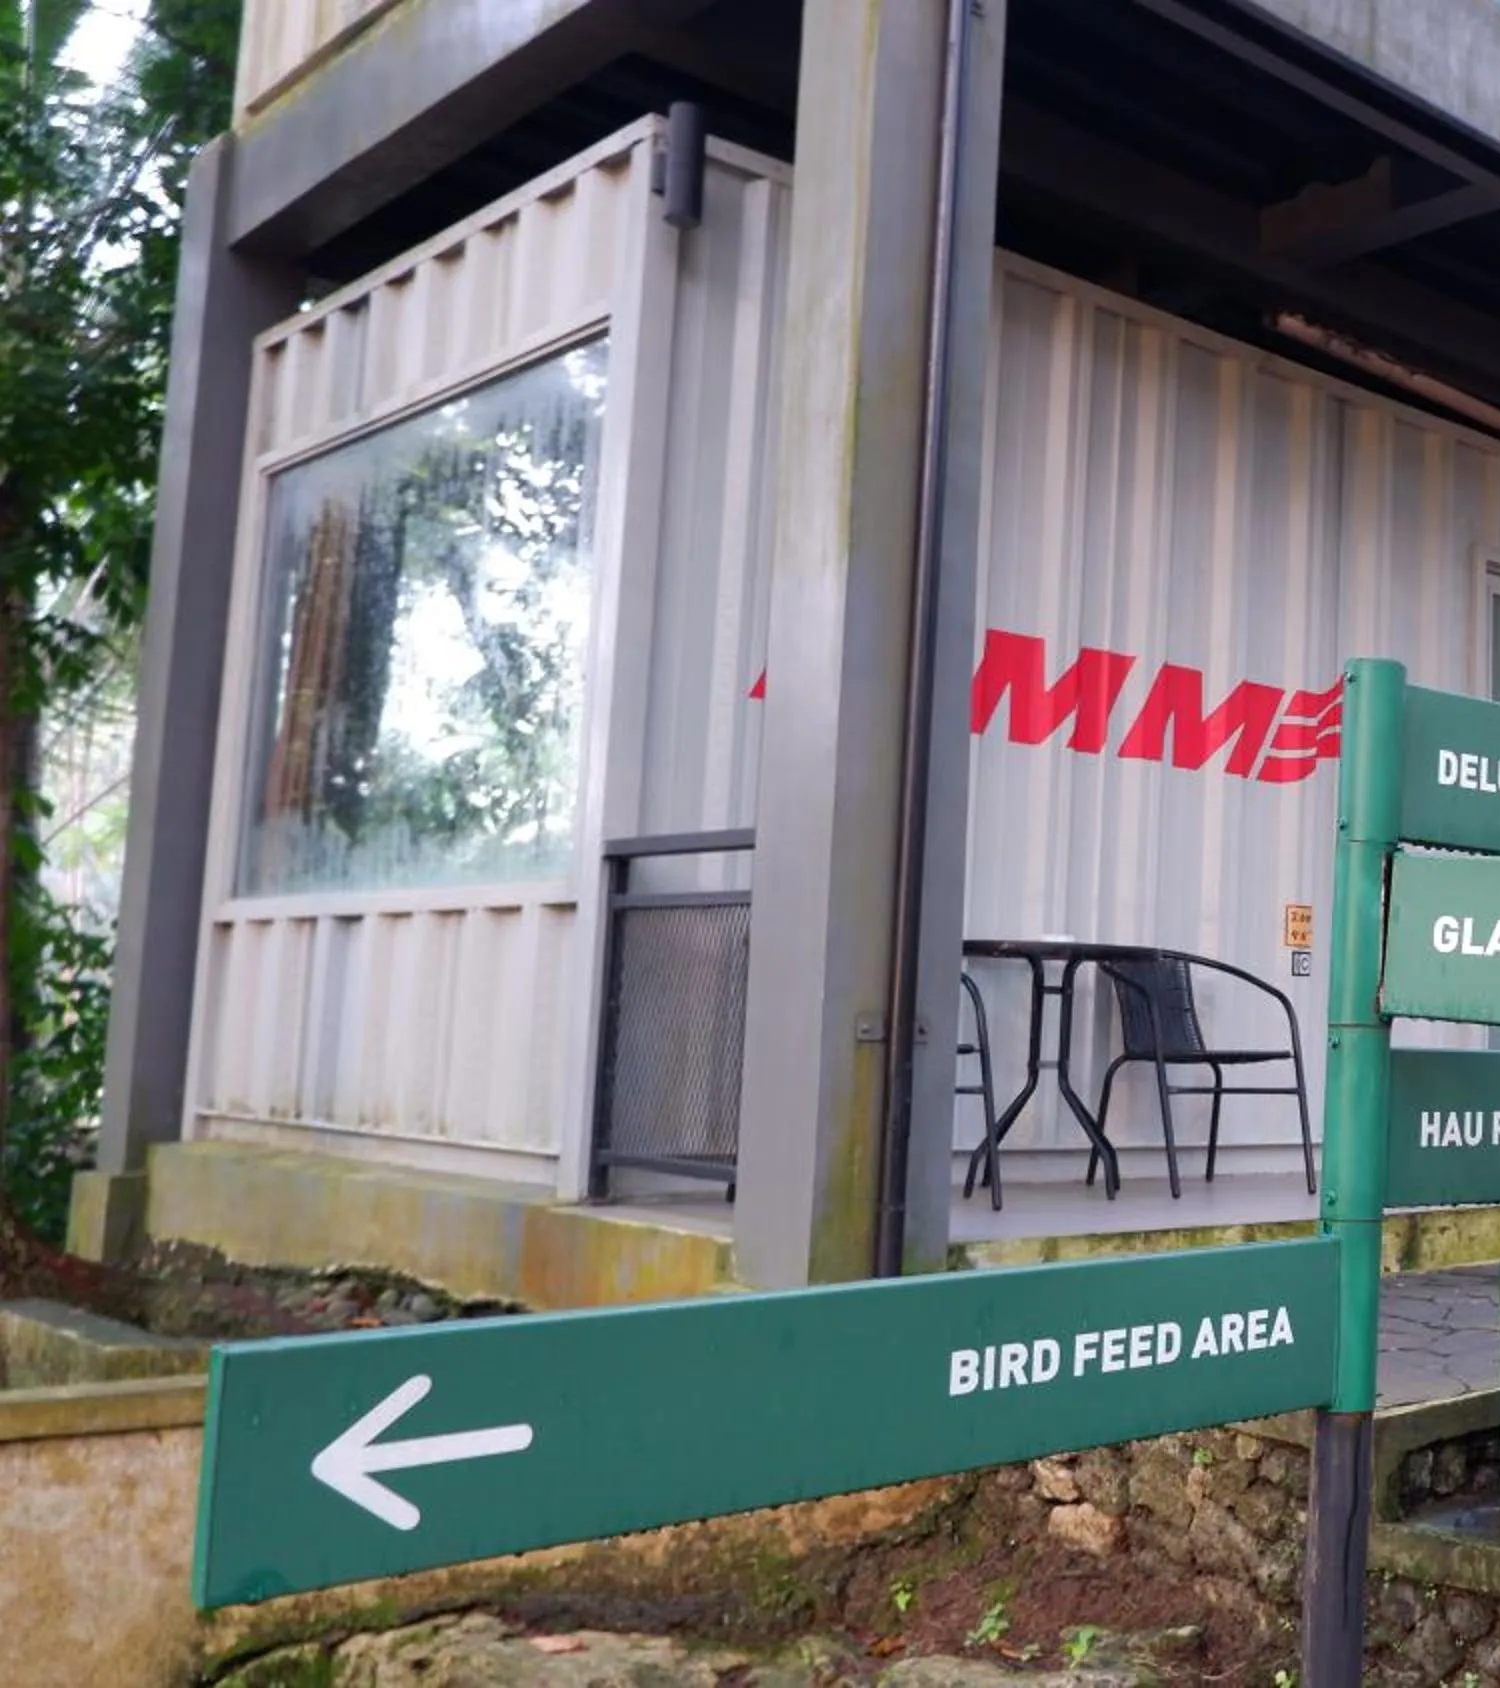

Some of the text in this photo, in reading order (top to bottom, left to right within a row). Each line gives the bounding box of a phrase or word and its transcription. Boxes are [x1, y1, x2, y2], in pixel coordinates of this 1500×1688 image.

[1419, 1110, 1484, 1147] HAU
[948, 1305, 1295, 1397] BIRD FEED AREA
